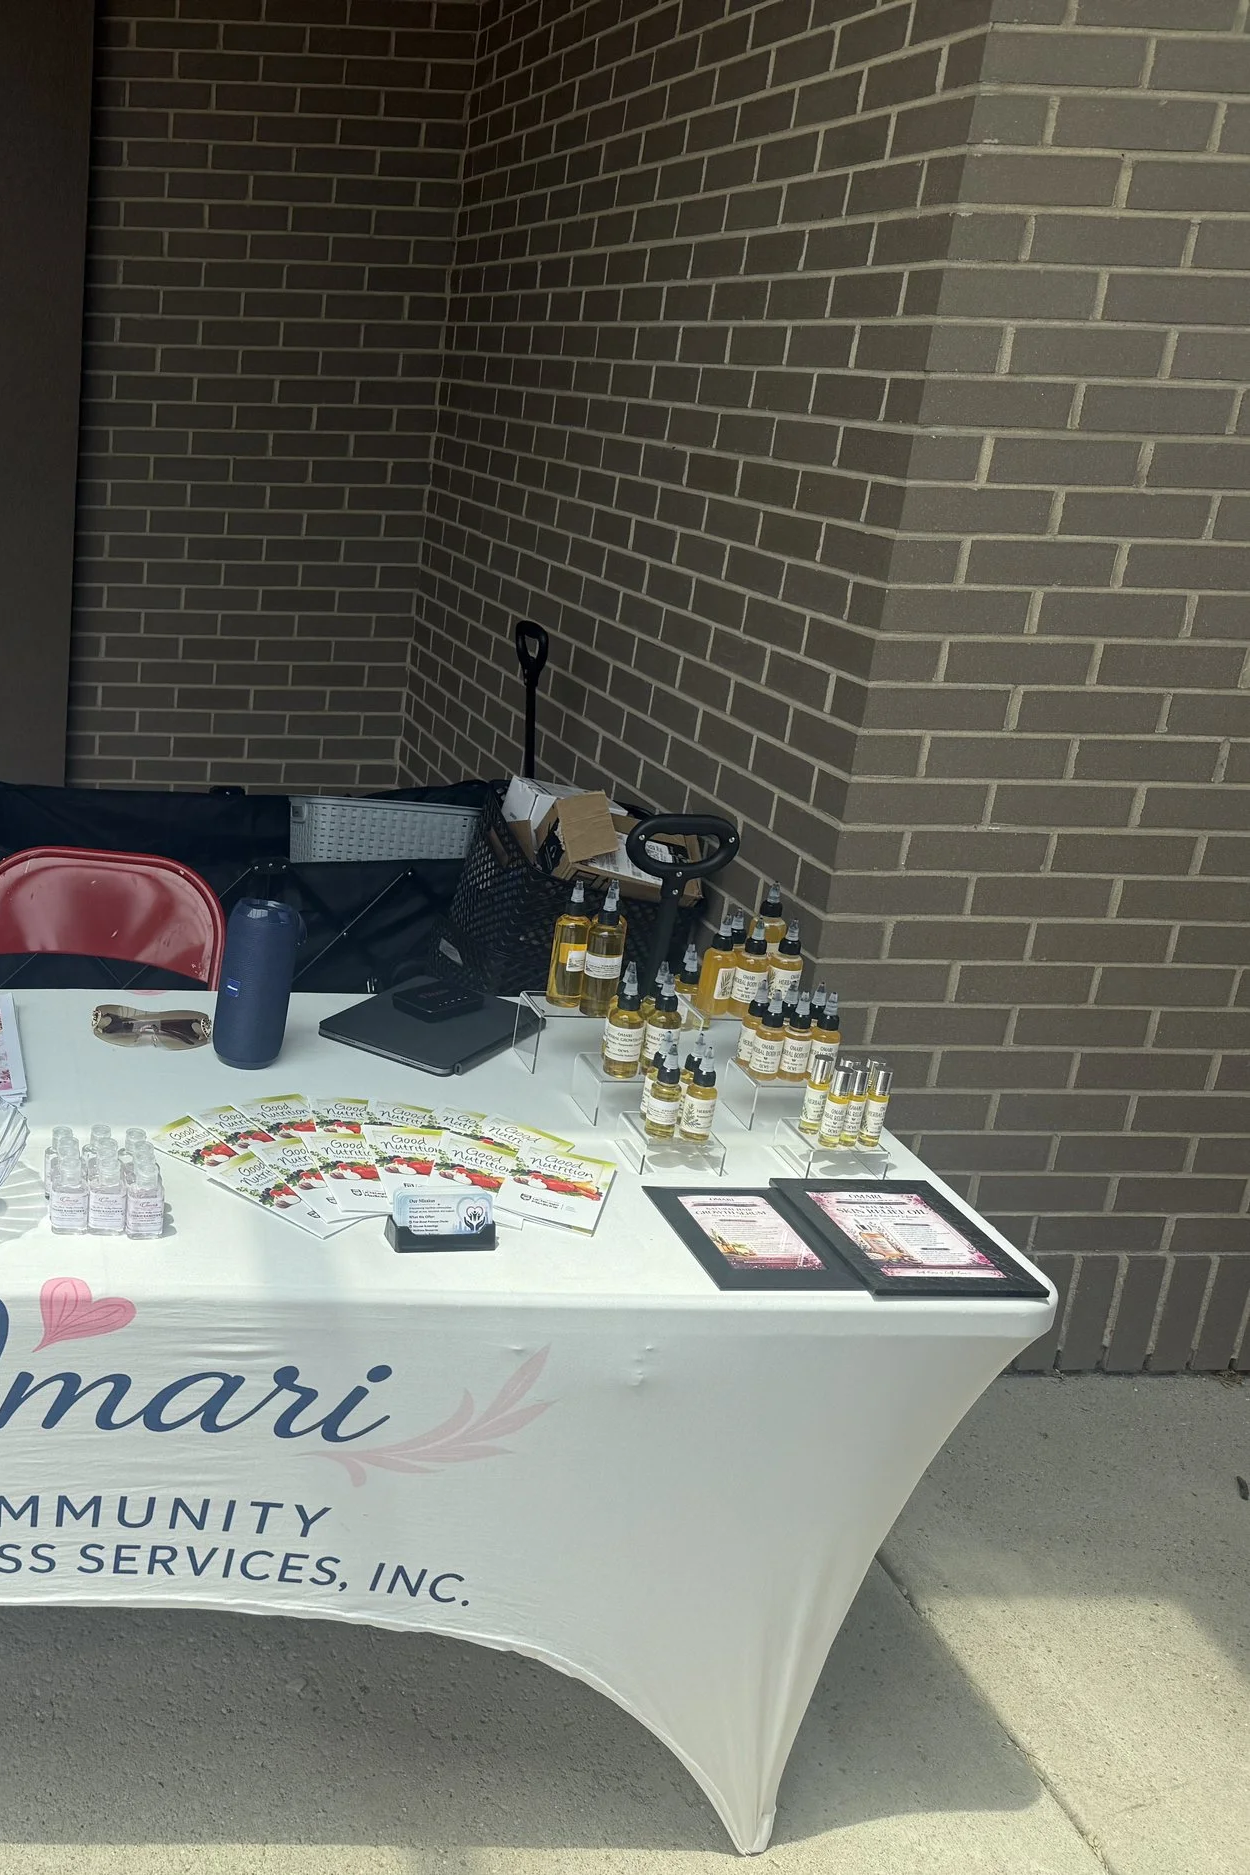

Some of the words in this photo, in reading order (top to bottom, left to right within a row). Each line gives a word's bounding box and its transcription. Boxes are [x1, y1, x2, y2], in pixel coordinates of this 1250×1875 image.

[261, 1102, 292, 1113] Good
[323, 1108, 365, 1119] Nutrit
[334, 1103, 368, 1113] Good
[392, 1107, 428, 1121] Good
[215, 1117, 248, 1129] Nutri
[380, 1110, 424, 1126] Nutriti
[169, 1125, 196, 1141] Good
[171, 1130, 211, 1149] Nutritio
[392, 1134, 427, 1145] Good
[489, 1126, 523, 1147] Nutri
[505, 1125, 542, 1145] Good
[331, 1140, 368, 1149] Good
[277, 1155, 310, 1166] Nutri
[466, 1147, 502, 1163] Good
[545, 1155, 584, 1170] Good
[238, 1160, 267, 1176] Good
[530, 1156, 594, 1179] Nutrition
[240, 1168, 274, 1187] Nutrit
[77, 1545, 348, 1592] SERVICES,
[370, 1562, 471, 1607] INC.
